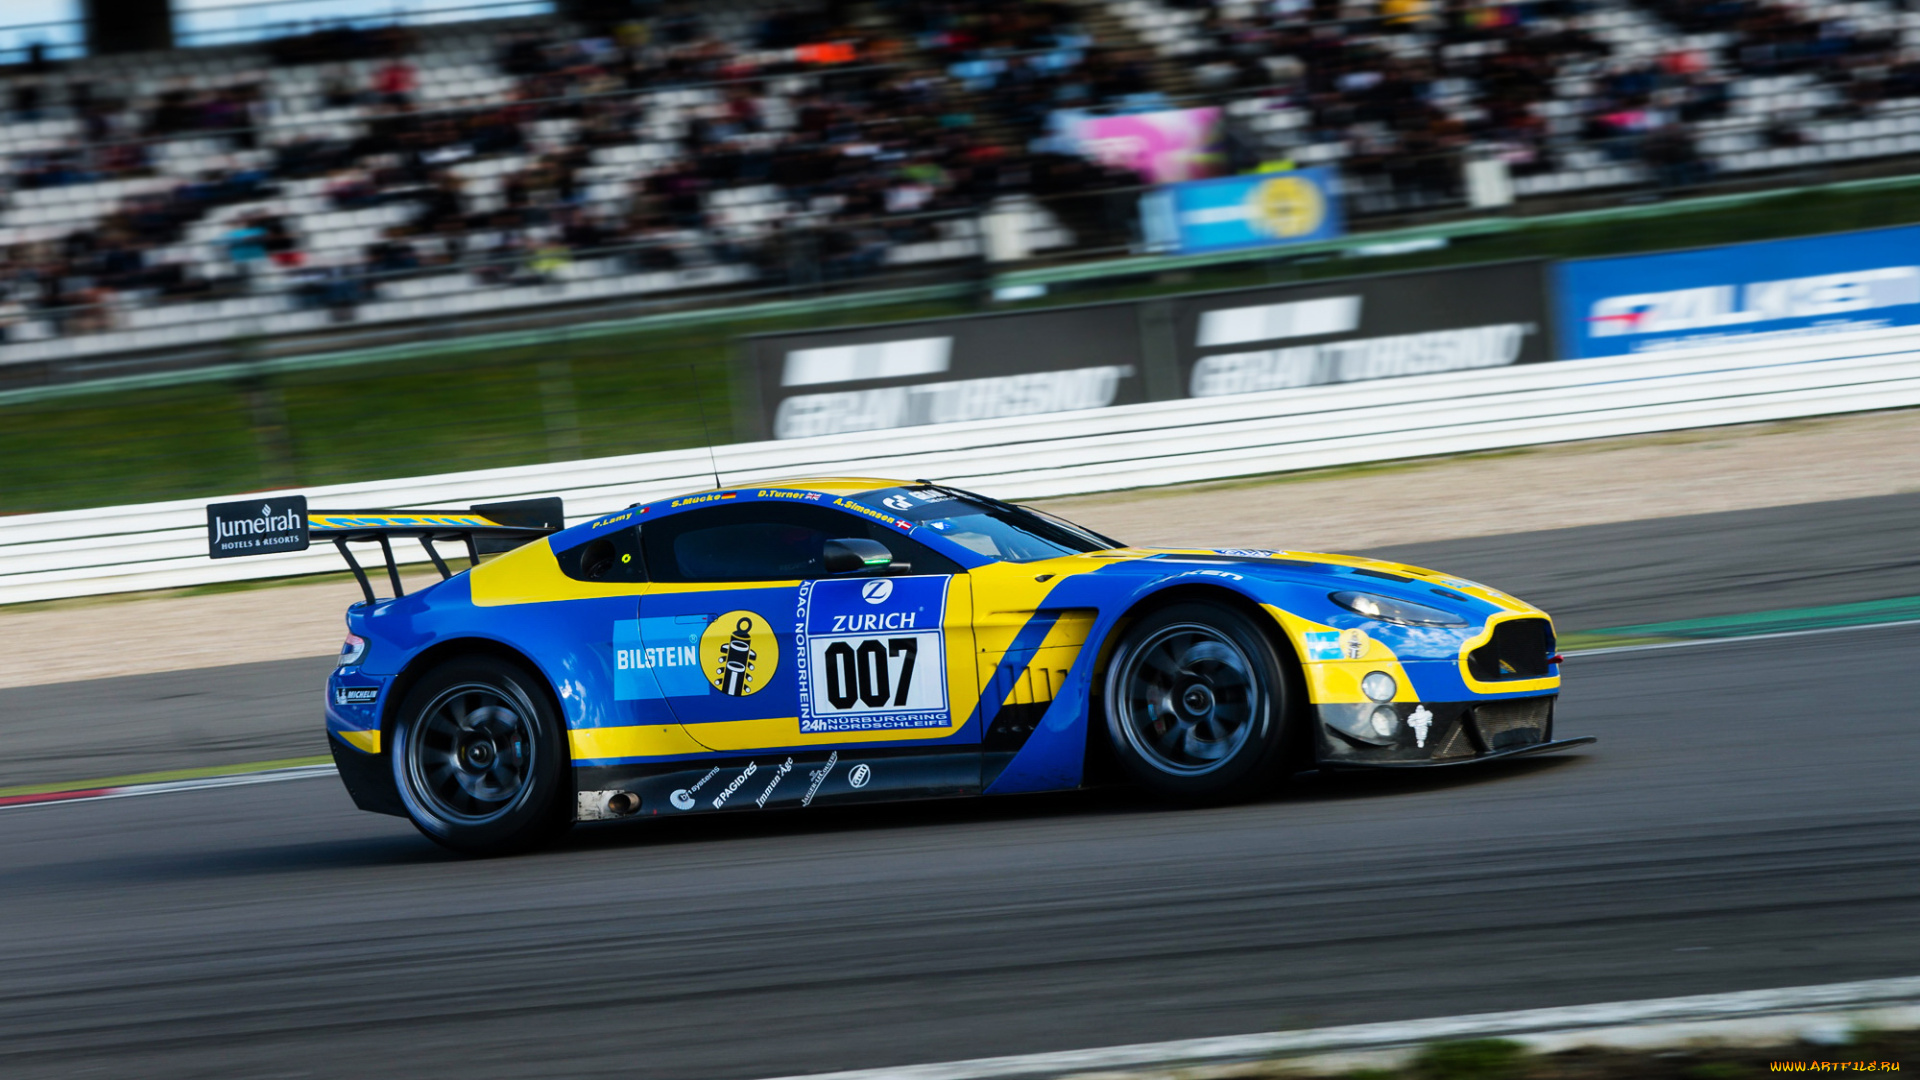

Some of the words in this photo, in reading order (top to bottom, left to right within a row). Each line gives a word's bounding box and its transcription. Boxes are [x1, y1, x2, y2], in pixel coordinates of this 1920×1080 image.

[758, 490, 805, 499] D.Turner
[214, 506, 301, 544] Jumeirah
[592, 512, 633, 529] P.Lamy
[221, 540, 253, 550] HOTELS
[255, 539, 261, 547] &
[263, 535, 299, 546] RESORTS
[796, 580, 812, 618] ADAC
[831, 612, 916, 632] ZURICH
[617, 645, 697, 670] BILSTEIN
[795, 623, 811, 719] NORDRHEIN
[824, 637, 918, 710] 007
[347, 690, 378, 699] MICHELIN
[801, 719, 827, 732] 24h
[827, 713, 947, 725] NÜRBURGRING
[828, 720, 948, 731] NORDSCHLEIFE
